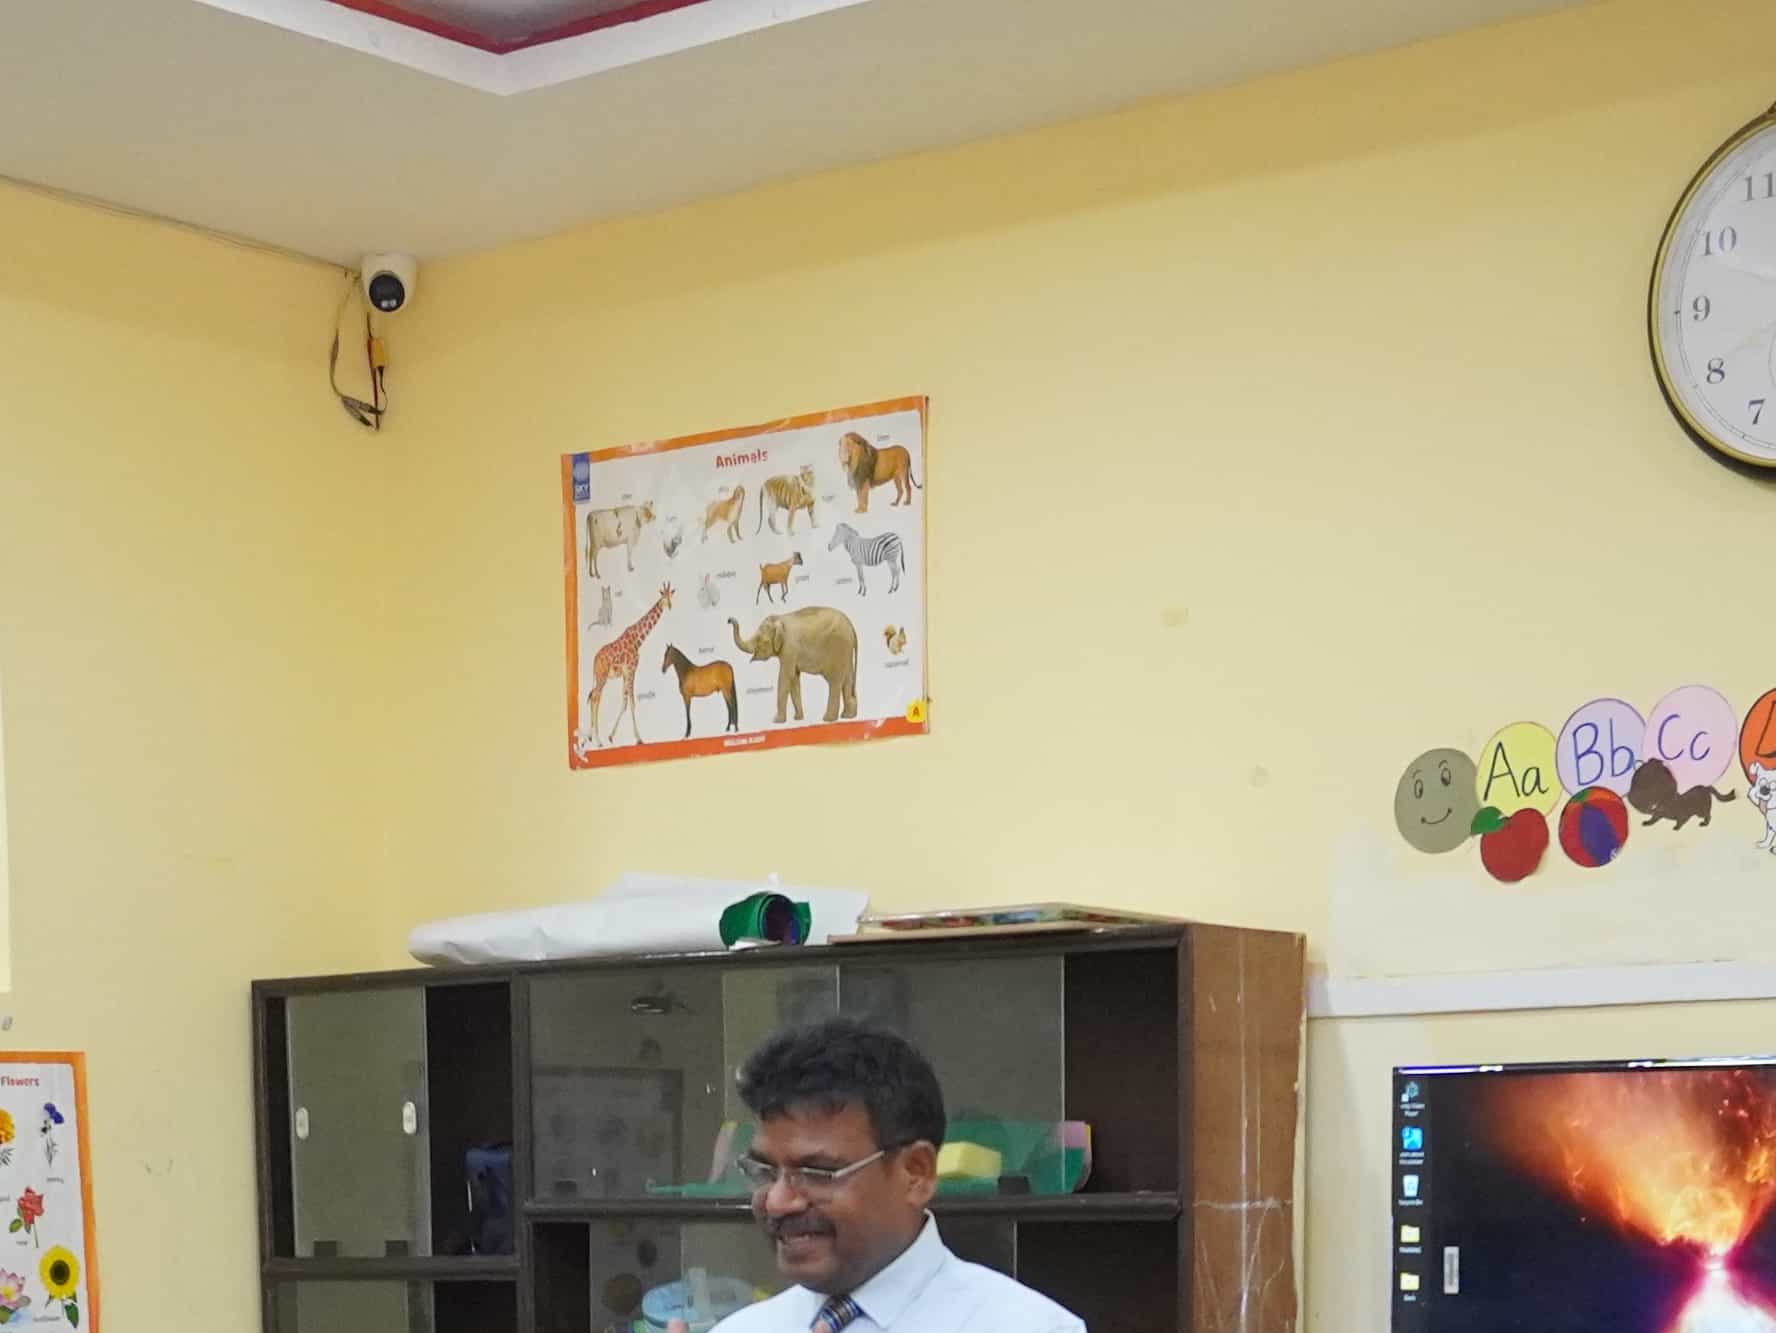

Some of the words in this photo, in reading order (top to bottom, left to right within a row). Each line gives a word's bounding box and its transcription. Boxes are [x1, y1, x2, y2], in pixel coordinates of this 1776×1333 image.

[1701, 226, 1738, 257] 10
[1691, 294, 1712, 322] 9
[1705, 356, 1727, 385] 8
[1747, 397, 1767, 426] 7
[715, 448, 769, 470] Animals
[1482, 741, 1550, 801] Aa
[1571, 717, 1635, 787] Bb
[1656, 713, 1712, 762] Cc
[0, 1075, 40, 1087] Flowers
